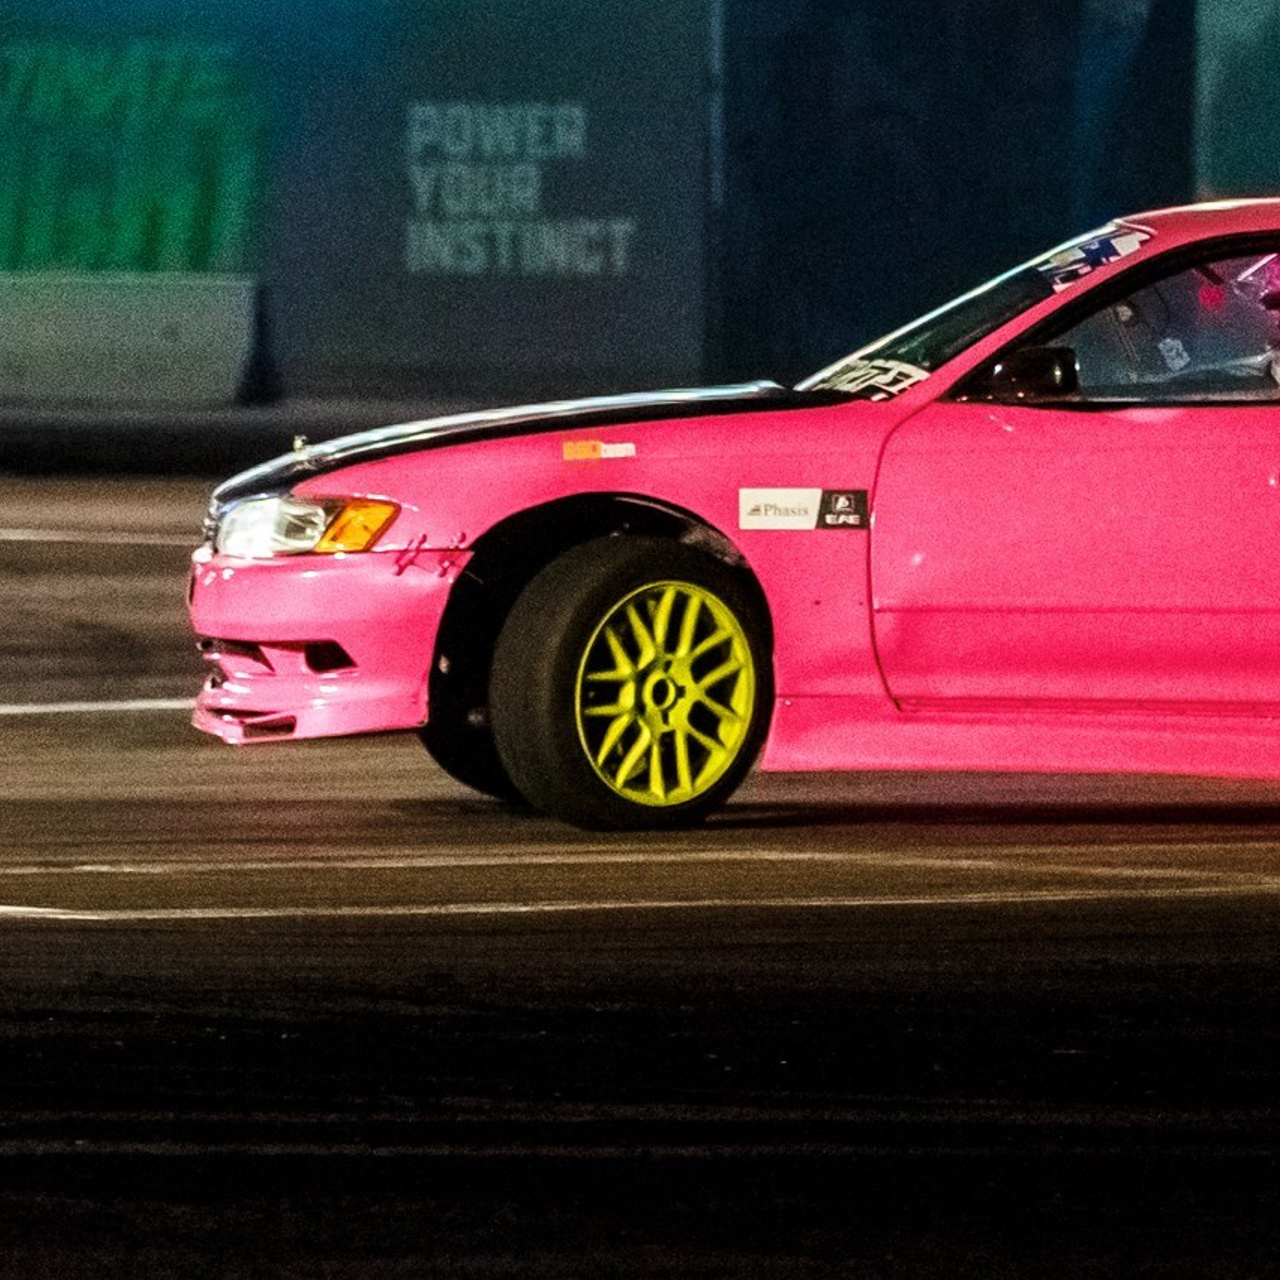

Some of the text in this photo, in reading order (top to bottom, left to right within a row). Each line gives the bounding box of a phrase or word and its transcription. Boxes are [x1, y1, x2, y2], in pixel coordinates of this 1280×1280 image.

[406, 102, 587, 159] POWER
[407, 163, 541, 215] YOUR
[405, 219, 637, 275] INSTINCT
[763, 503, 809, 517] Phasis
